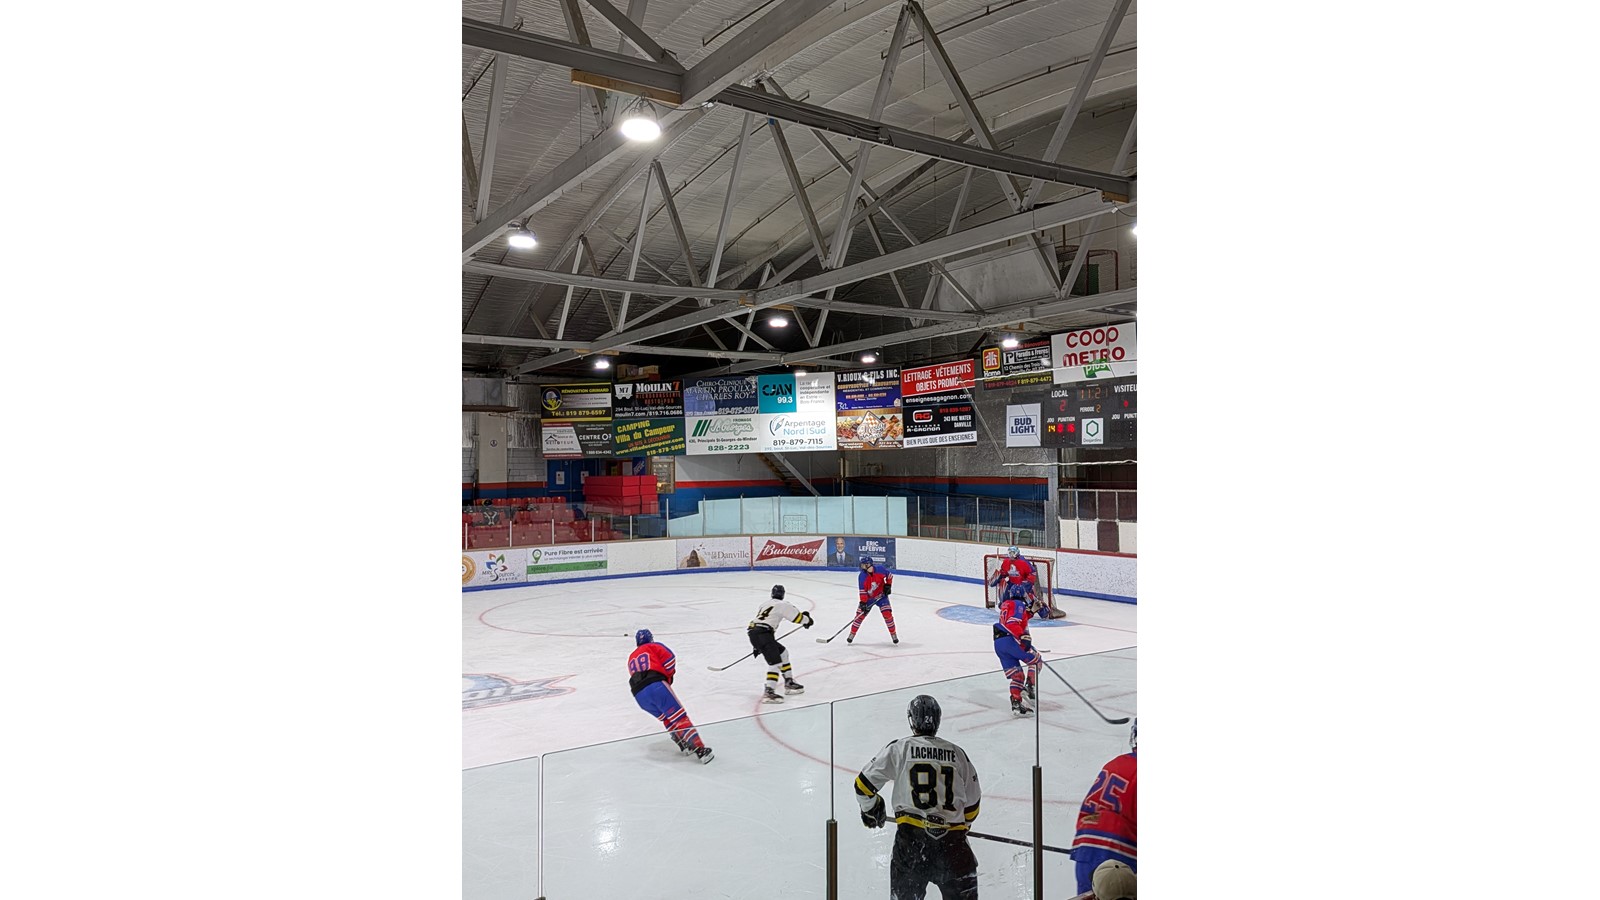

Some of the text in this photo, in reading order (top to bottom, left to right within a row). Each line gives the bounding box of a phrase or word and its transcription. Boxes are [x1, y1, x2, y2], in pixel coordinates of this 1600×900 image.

[1066, 326, 1119, 346] COOP
[1063, 346, 1126, 367] METRO
[886, 369, 900, 378] INC.
[904, 370, 932, 383] LETTRAGE
[936, 364, 972, 378] VÊTEMENTS
[636, 382, 680, 392] MOULIN 7
[762, 384, 792, 396] CJAN
[916, 380, 937, 392] OBJETS
[696, 392, 732, 400] CHARLES
[1060, 400, 1066, 412] 2
[1096, 404, 1101, 413] 2
[617, 420, 650, 433] CAMPING
[1014, 417, 1032, 425] BUD
[615, 434, 630, 444] Villa
[644, 425, 675, 437] Campeur
[1011, 425, 1035, 434] LIGHT
[773, 438, 824, 446] 819-879-7115
[949, 433, 974, 442] ENSEIGNES
[717, 550, 749, 558] Danville
[762, 544, 818, 556] Budweiser
[925, 715, 933, 724] 24
[910, 764, 957, 812] 81
[1080, 769, 1129, 814] 25
